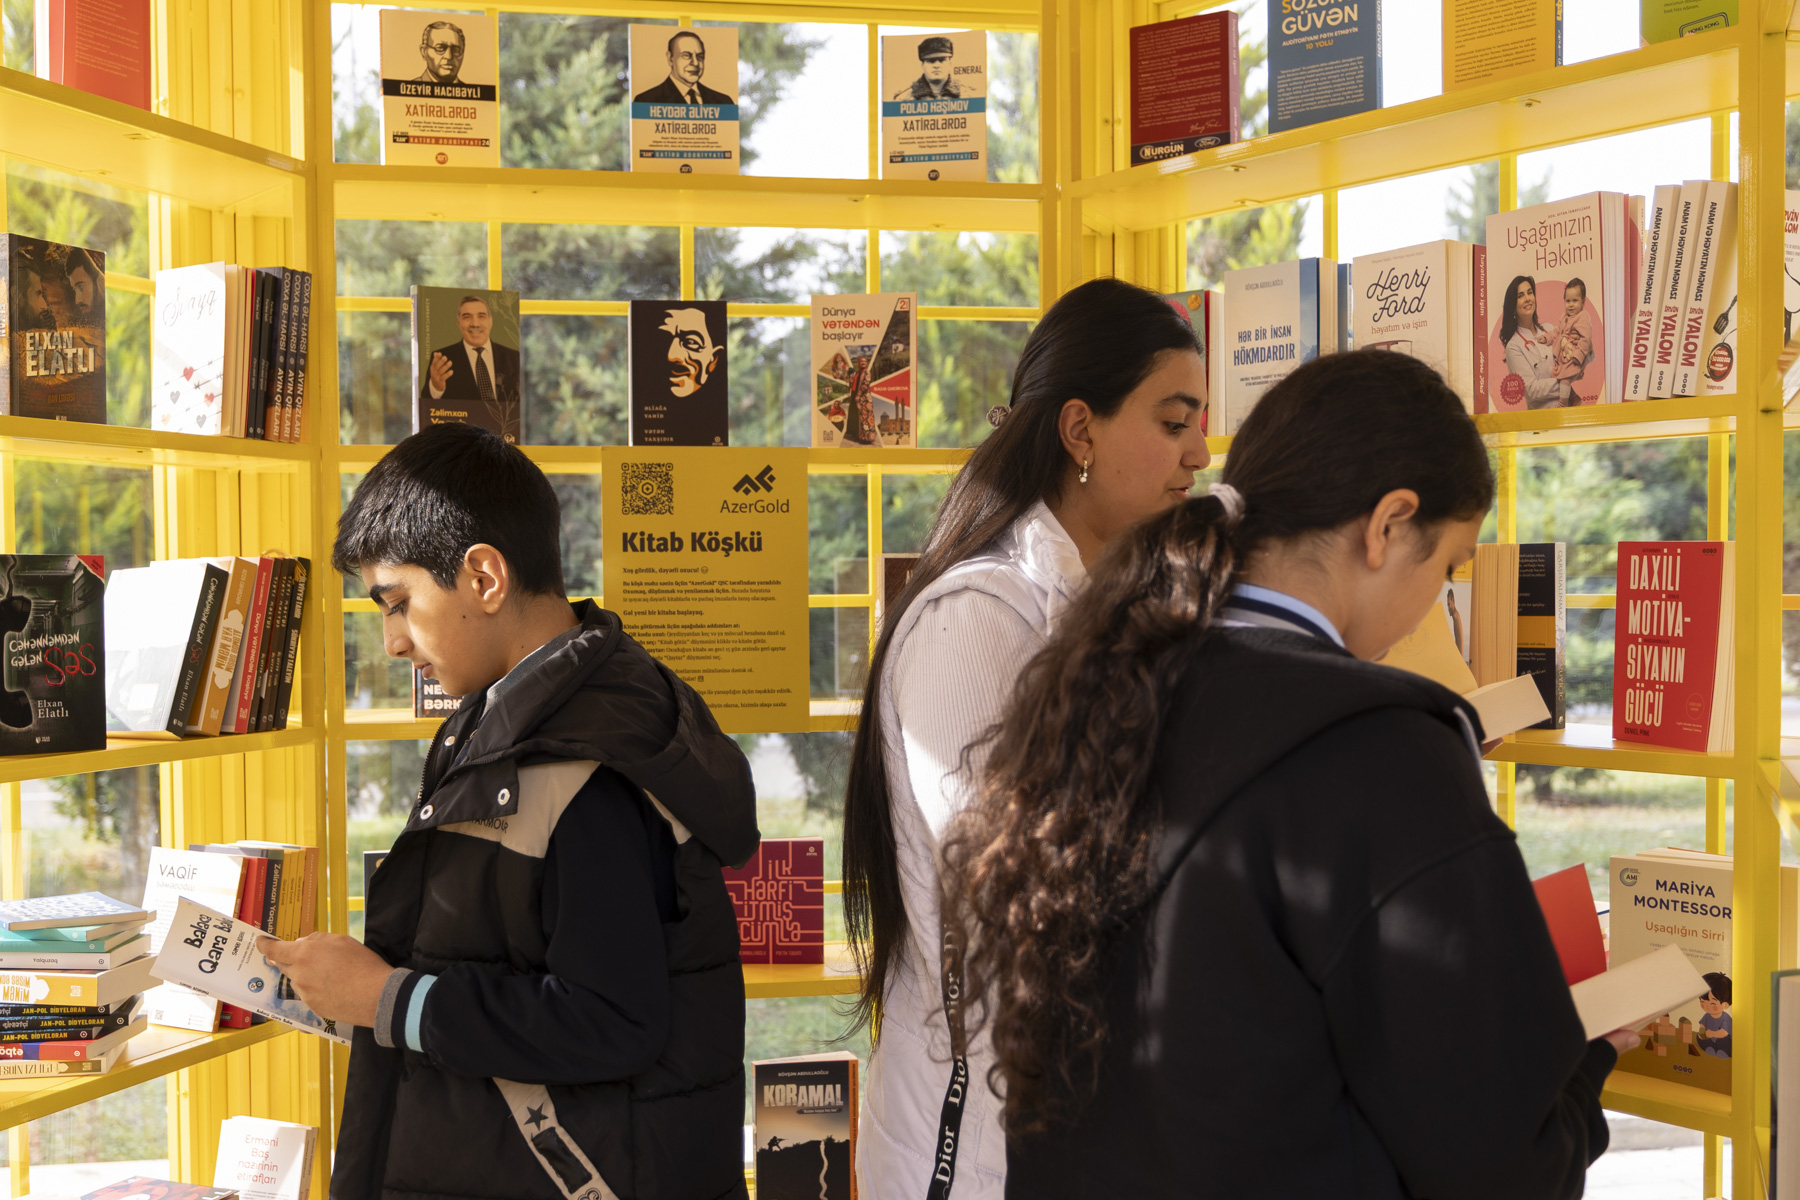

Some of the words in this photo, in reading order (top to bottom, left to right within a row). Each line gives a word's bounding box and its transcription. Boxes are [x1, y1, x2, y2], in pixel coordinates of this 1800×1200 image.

[1281, 4, 1358, 35] GÜVƏN
[1687, 26, 1704, 34] HONG
[1704, 21, 1720, 29] KONG
[1315, 39, 1334, 48] YOLU
[953, 65, 983, 75] GENERAL
[400, 83, 431, 95] ÜZEYİR
[434, 86, 480, 98] HACIBƏYLİ
[405, 103, 477, 119] XATİRƏLƏRDƏ
[649, 105, 686, 118] HEYDƏR
[689, 104, 720, 119] ƏLİYEV
[900, 102, 928, 114] POLAD
[930, 100, 969, 114] HƏŞİMOV
[654, 121, 716, 134] XATİRƏLƏRDƏ
[902, 117, 967, 132] XATİRƏLƏRDƏ
[481, 139, 490, 147] 24
[1144, 141, 1184, 157] NURGÜN
[1654, 207, 1663, 231] ANAM
[1683, 201, 1691, 223] ANAM
[1709, 202, 1717, 224] ANAM
[1507, 214, 1593, 252] Uşağınızın
[1535, 237, 1594, 271] Həkimi
[1648, 242, 1659, 274] HƏYATIN
[1675, 235, 1687, 271] HƏYATIN
[1700, 236, 1712, 272] HƏYATIN
[283, 272, 291, 301] COXA
[293, 274, 301, 302] COXA
[303, 275, 311, 304] COXA
[1644, 275, 1654, 304] MƏNASI
[1669, 272, 1680, 300] MƏNASI
[1694, 272, 1705, 301] MƏNASI
[822, 307, 856, 318] Dünya
[1373, 294, 1426, 323] Ford
[822, 319, 880, 329] VƏTƏNDƏN
[1238, 330, 1252, 343] HƏR
[1255, 326, 1267, 341] BİR
[1270, 324, 1292, 339] İNSAN
[1371, 323, 1400, 335] həyatım
[1412, 319, 1428, 330] işim
[26, 330, 74, 351] ELXAN
[822, 331, 865, 342] başlayır
[1631, 317, 1652, 368] YALOM
[1656, 314, 1677, 365] YALOM
[1680, 316, 1702, 367] YALOM
[26, 345, 97, 378] ELATLI
[1233, 343, 1296, 366] HÖKMDARDIR
[275, 367, 284, 394] AYIN
[286, 369, 295, 394] AYIN
[296, 370, 305, 395] AYIN
[273, 394, 282, 437] QIZLARI
[283, 395, 293, 438] QIZLARI
[293, 396, 303, 438] QIZLARI
[429, 408, 468, 418] Zəlimxan
[720, 499, 790, 514] AzerGold
[622, 531, 684, 552] Kitab
[691, 531, 763, 557] Köşkü
[1630, 548, 1681, 591] DAXİLİ
[1628, 594, 1691, 638] MOTİVA-
[1626, 637, 1686, 684] SİYANIN
[183, 670, 194, 691] Elxan
[37, 700, 63, 708] Elxan
[37, 707, 69, 719] Elatlı
[1625, 682, 1664, 727] GÜCÜ
[159, 863, 198, 880] VAQİF
[270, 863, 281, 904] Zəlimxan
[1626, 873, 1638, 881] AMI
[1655, 879, 1716, 898] MARİYA
[267, 904, 277, 934] Yaqub
[1633, 895, 1732, 920] MONTESSOR
[1645, 920, 1698, 938] Uşaqlığın
[1701, 928, 1725, 942] Sirri
[198, 935, 228, 974] Qara
[2, 985, 30, 1003] MƏNİM
[11, 976, 31, 988] SƏSİM
[0, 1046, 24, 1058] öqtə
[763, 1083, 844, 1107] KORAMAL
[244, 1134, 279, 1147] Erməni
[251, 1147, 270, 1160] Baş
[935, 1125, 955, 1185] Dior
